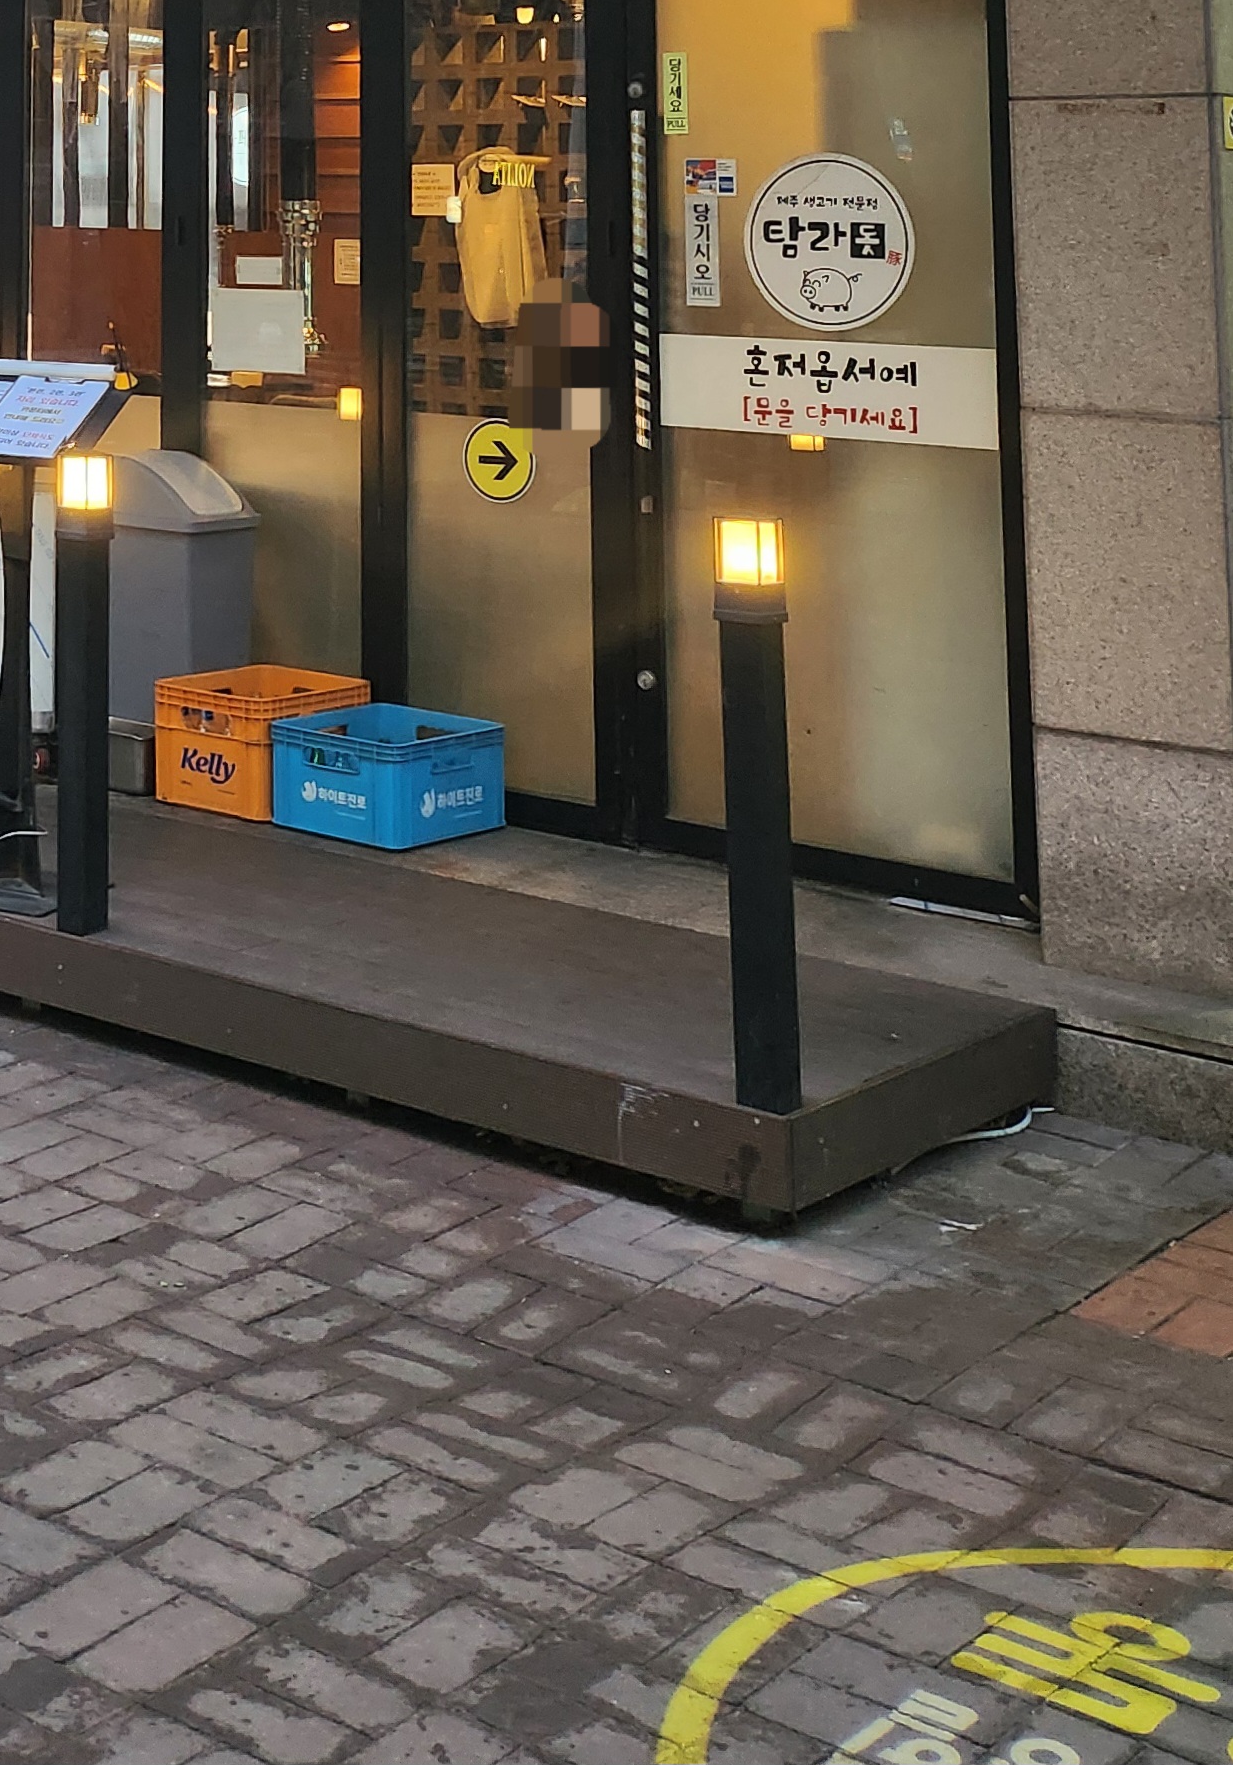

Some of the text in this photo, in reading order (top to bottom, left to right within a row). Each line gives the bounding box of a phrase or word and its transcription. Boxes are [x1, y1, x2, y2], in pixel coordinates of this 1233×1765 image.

[777, 195, 878, 211] 제주 생고기 전문점
[694, 203, 712, 279] 당기시오
[764, 216, 885, 259] 탐라돗
[692, 286, 714, 296] PULL
[744, 345, 918, 393] 혼저옵서예
[743, 396, 918, 434] [문을 당기세요]
[181, 747, 236, 784] Kelly
[318, 787, 366, 809] 하이트진로
[437, 786, 484, 808] 하이트진로
